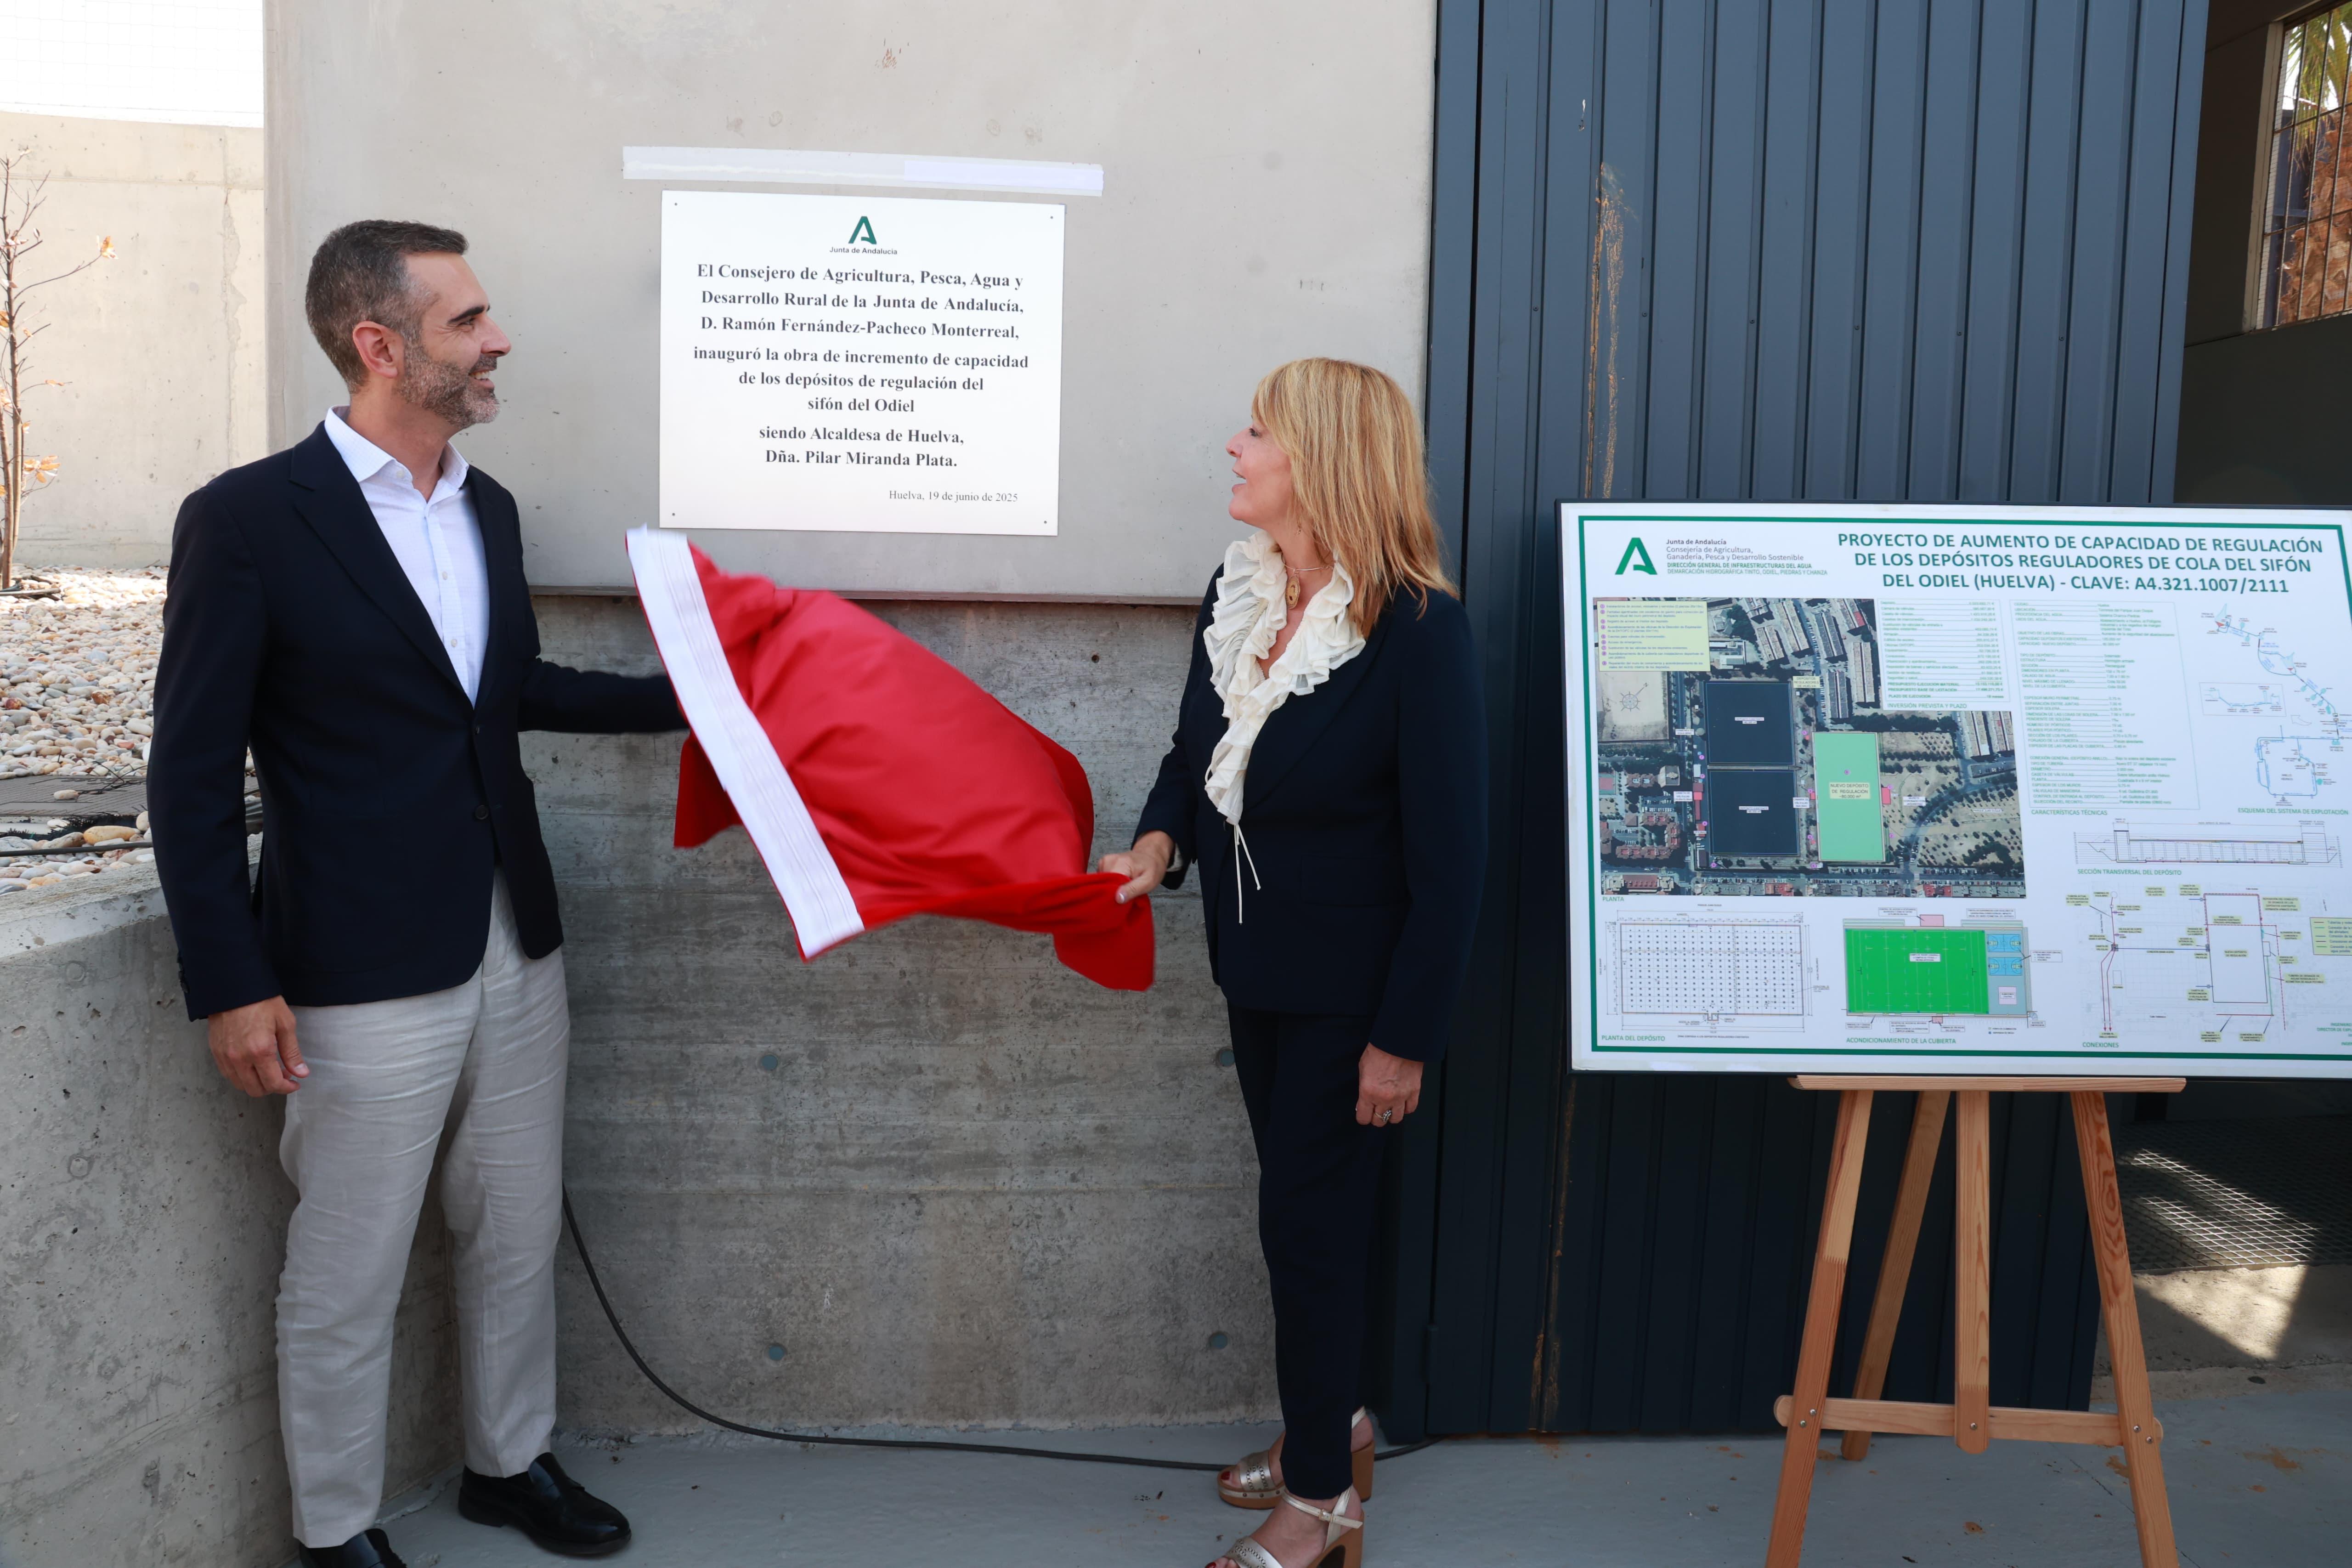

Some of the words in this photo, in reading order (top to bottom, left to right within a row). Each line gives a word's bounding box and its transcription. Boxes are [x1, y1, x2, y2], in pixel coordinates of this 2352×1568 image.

[698, 264, 712, 277] El
[718, 265, 795, 282] Consejero
[801, 267, 818, 279] de
[823, 268, 914, 284] Agricultura,
[921, 271, 966, 286] Pesca,
[971, 273, 1009, 289] Agua
[1015, 278, 1023, 290] y
[702, 291, 779, 304] Desarrollo
[785, 293, 826, 306] Rural
[832, 295, 848, 307] de
[854, 295, 866, 307] la
[873, 295, 915, 308] Junta
[921, 297, 938, 309] de
[944, 298, 1023, 313] Andalucía,
[702, 317, 717, 329] D.
[723, 317, 775, 330] Ramón
[782, 319, 926, 334] Fernández-Pacheco
[932, 323, 1018, 339] Monterreal,
[695, 346, 761, 363] inauguró
[767, 348, 778, 360] la
[784, 349, 818, 361] obra
[824, 350, 840, 362] de
[846, 350, 927, 364] incremento
[933, 353, 950, 365] de
[955, 355, 1028, 369] capacidad
[739, 372, 755, 384] de
[761, 372, 780, 384] los
[786, 373, 853, 389] depósitos
[859, 375, 875, 387] de
[881, 376, 956, 391] regulación
[962, 378, 983, 390] del
[808, 397, 842, 410] sifón
[848, 398, 869, 411] del
[875, 399, 914, 412] Odiel
[760, 426, 806, 439] siendo
[810, 428, 880, 441] Alcaldesa
[886, 430, 902, 441] de
[909, 430, 963, 444] Huelva,
[766, 450, 799, 463] Dña.
[806, 451, 841, 464] Pilar
[847, 452, 910, 465] Miranda
[916, 454, 956, 466] Plata.
[890, 491, 924, 500] Huelva,
[929, 491, 940, 500] 19
[954, 492, 979, 503] junio
[982, 492, 992, 501] de
[996, 493, 1018, 502] 2025
[1666, 546, 1702, 555] Consejería
[1713, 547, 1753, 555] Agricultura,
[1838, 534, 1928, 547] PROYECTO
[1934, 535, 1955, 547] DE
[1960, 535, 2049, 549] AUMENTO
[2055, 536, 2076, 548] DE
[2082, 537, 2180, 550] CAPACIDAD
[2185, 538, 2207, 550] DE
[2212, 537, 2322, 553] REGULACIÓN
[1855, 553, 1877, 566] DE
[1882, 554, 1913, 566] LOS
[1919, 551, 2013, 567] DEPÓSITOS
[2019, 555, 2143, 569] REGULADORES
[2148, 557, 2170, 569] DE
[2176, 557, 2221, 570] COLA
[2225, 558, 2256, 571] DEL
[2260, 556, 2311, 572] SIFÓN
[1883, 574, 1914, 587] DEL
[1919, 575, 1969, 587] ODIEL
[1974, 574, 2054, 591] (HUELVA)
[2071, 576, 2129, 589] CLAVE:
[2135, 577, 2289, 594] A4.321.1007/2111
